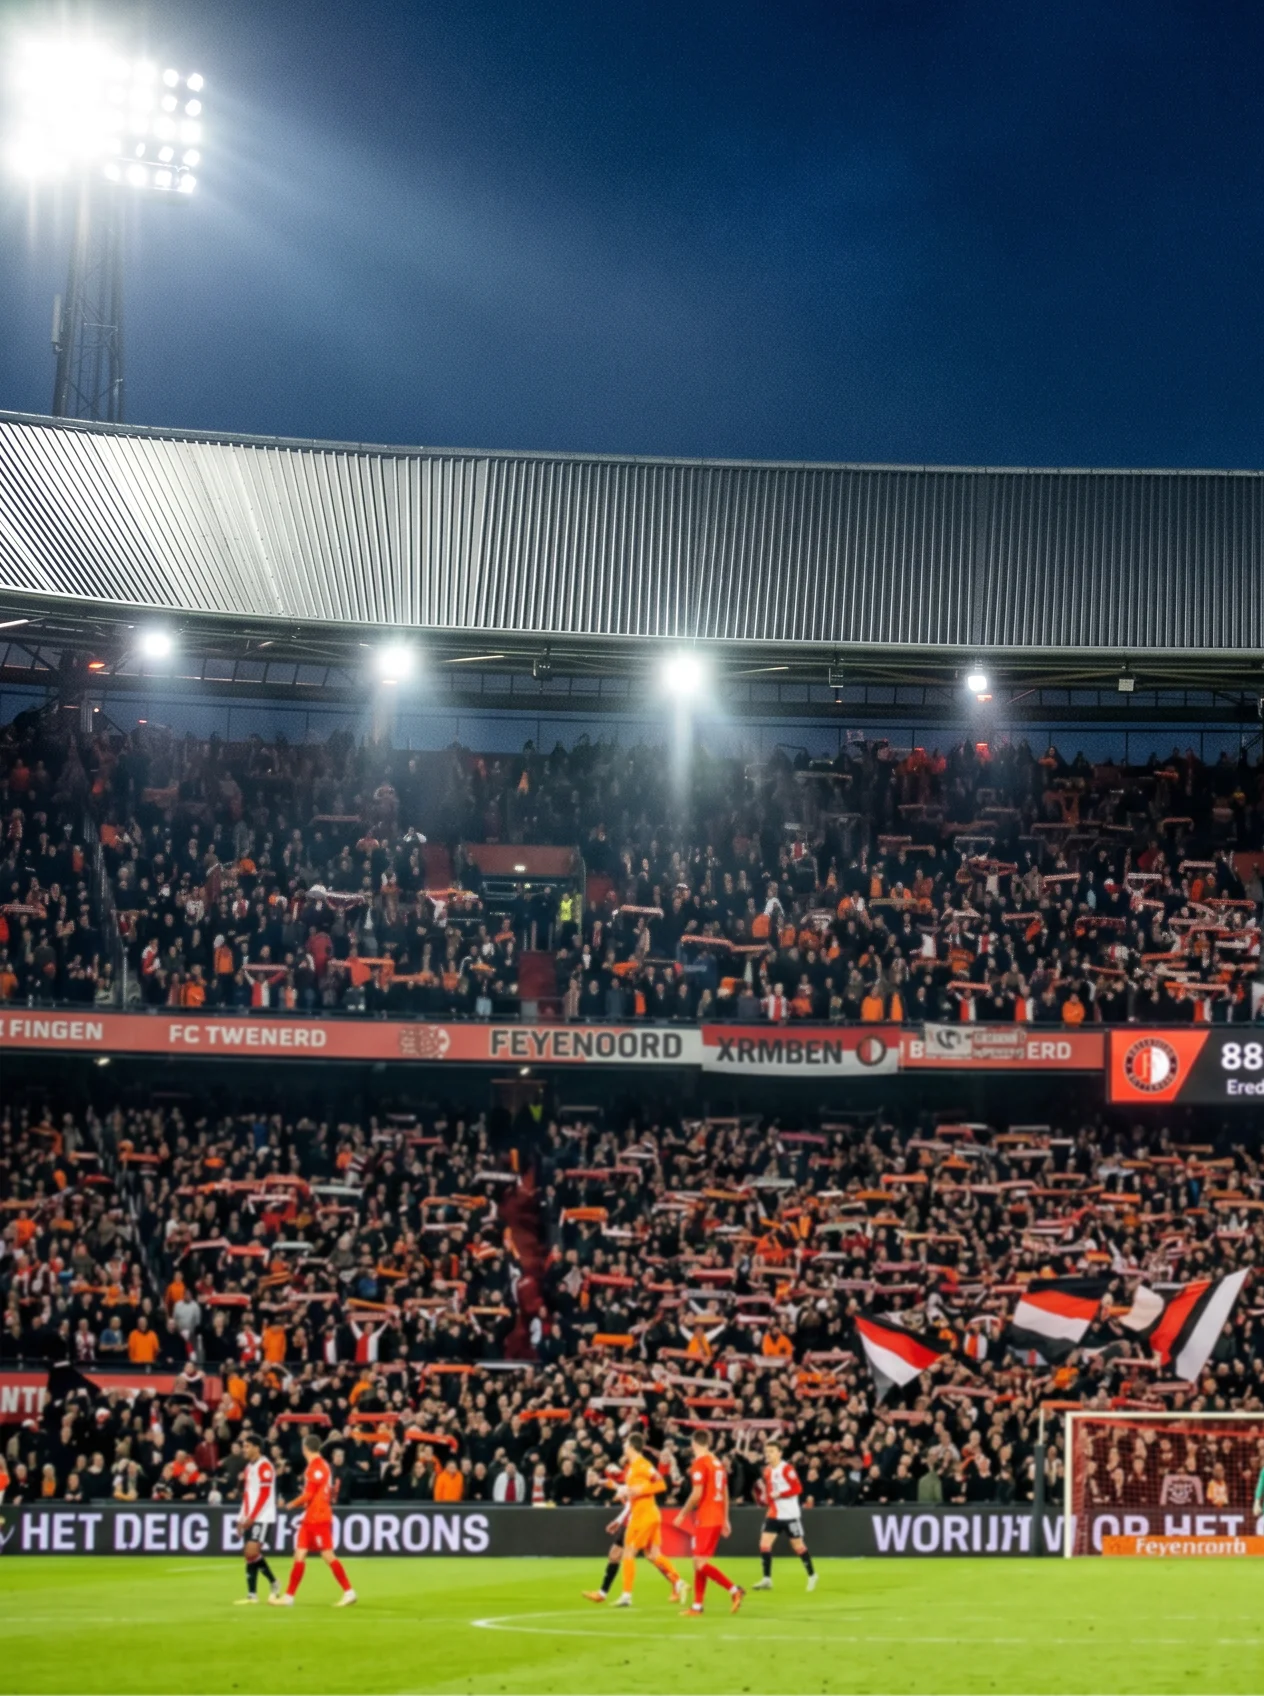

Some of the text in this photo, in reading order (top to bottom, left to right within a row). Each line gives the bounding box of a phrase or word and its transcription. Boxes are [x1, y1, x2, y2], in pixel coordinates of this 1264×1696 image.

[9, 1019, 103, 1040] FINGEN
[169, 1024, 200, 1044] FC
[490, 1028, 683, 1059] FEYENOORD
[22, 1513, 103, 1550] HET
[114, 1513, 209, 1551] DEIG
